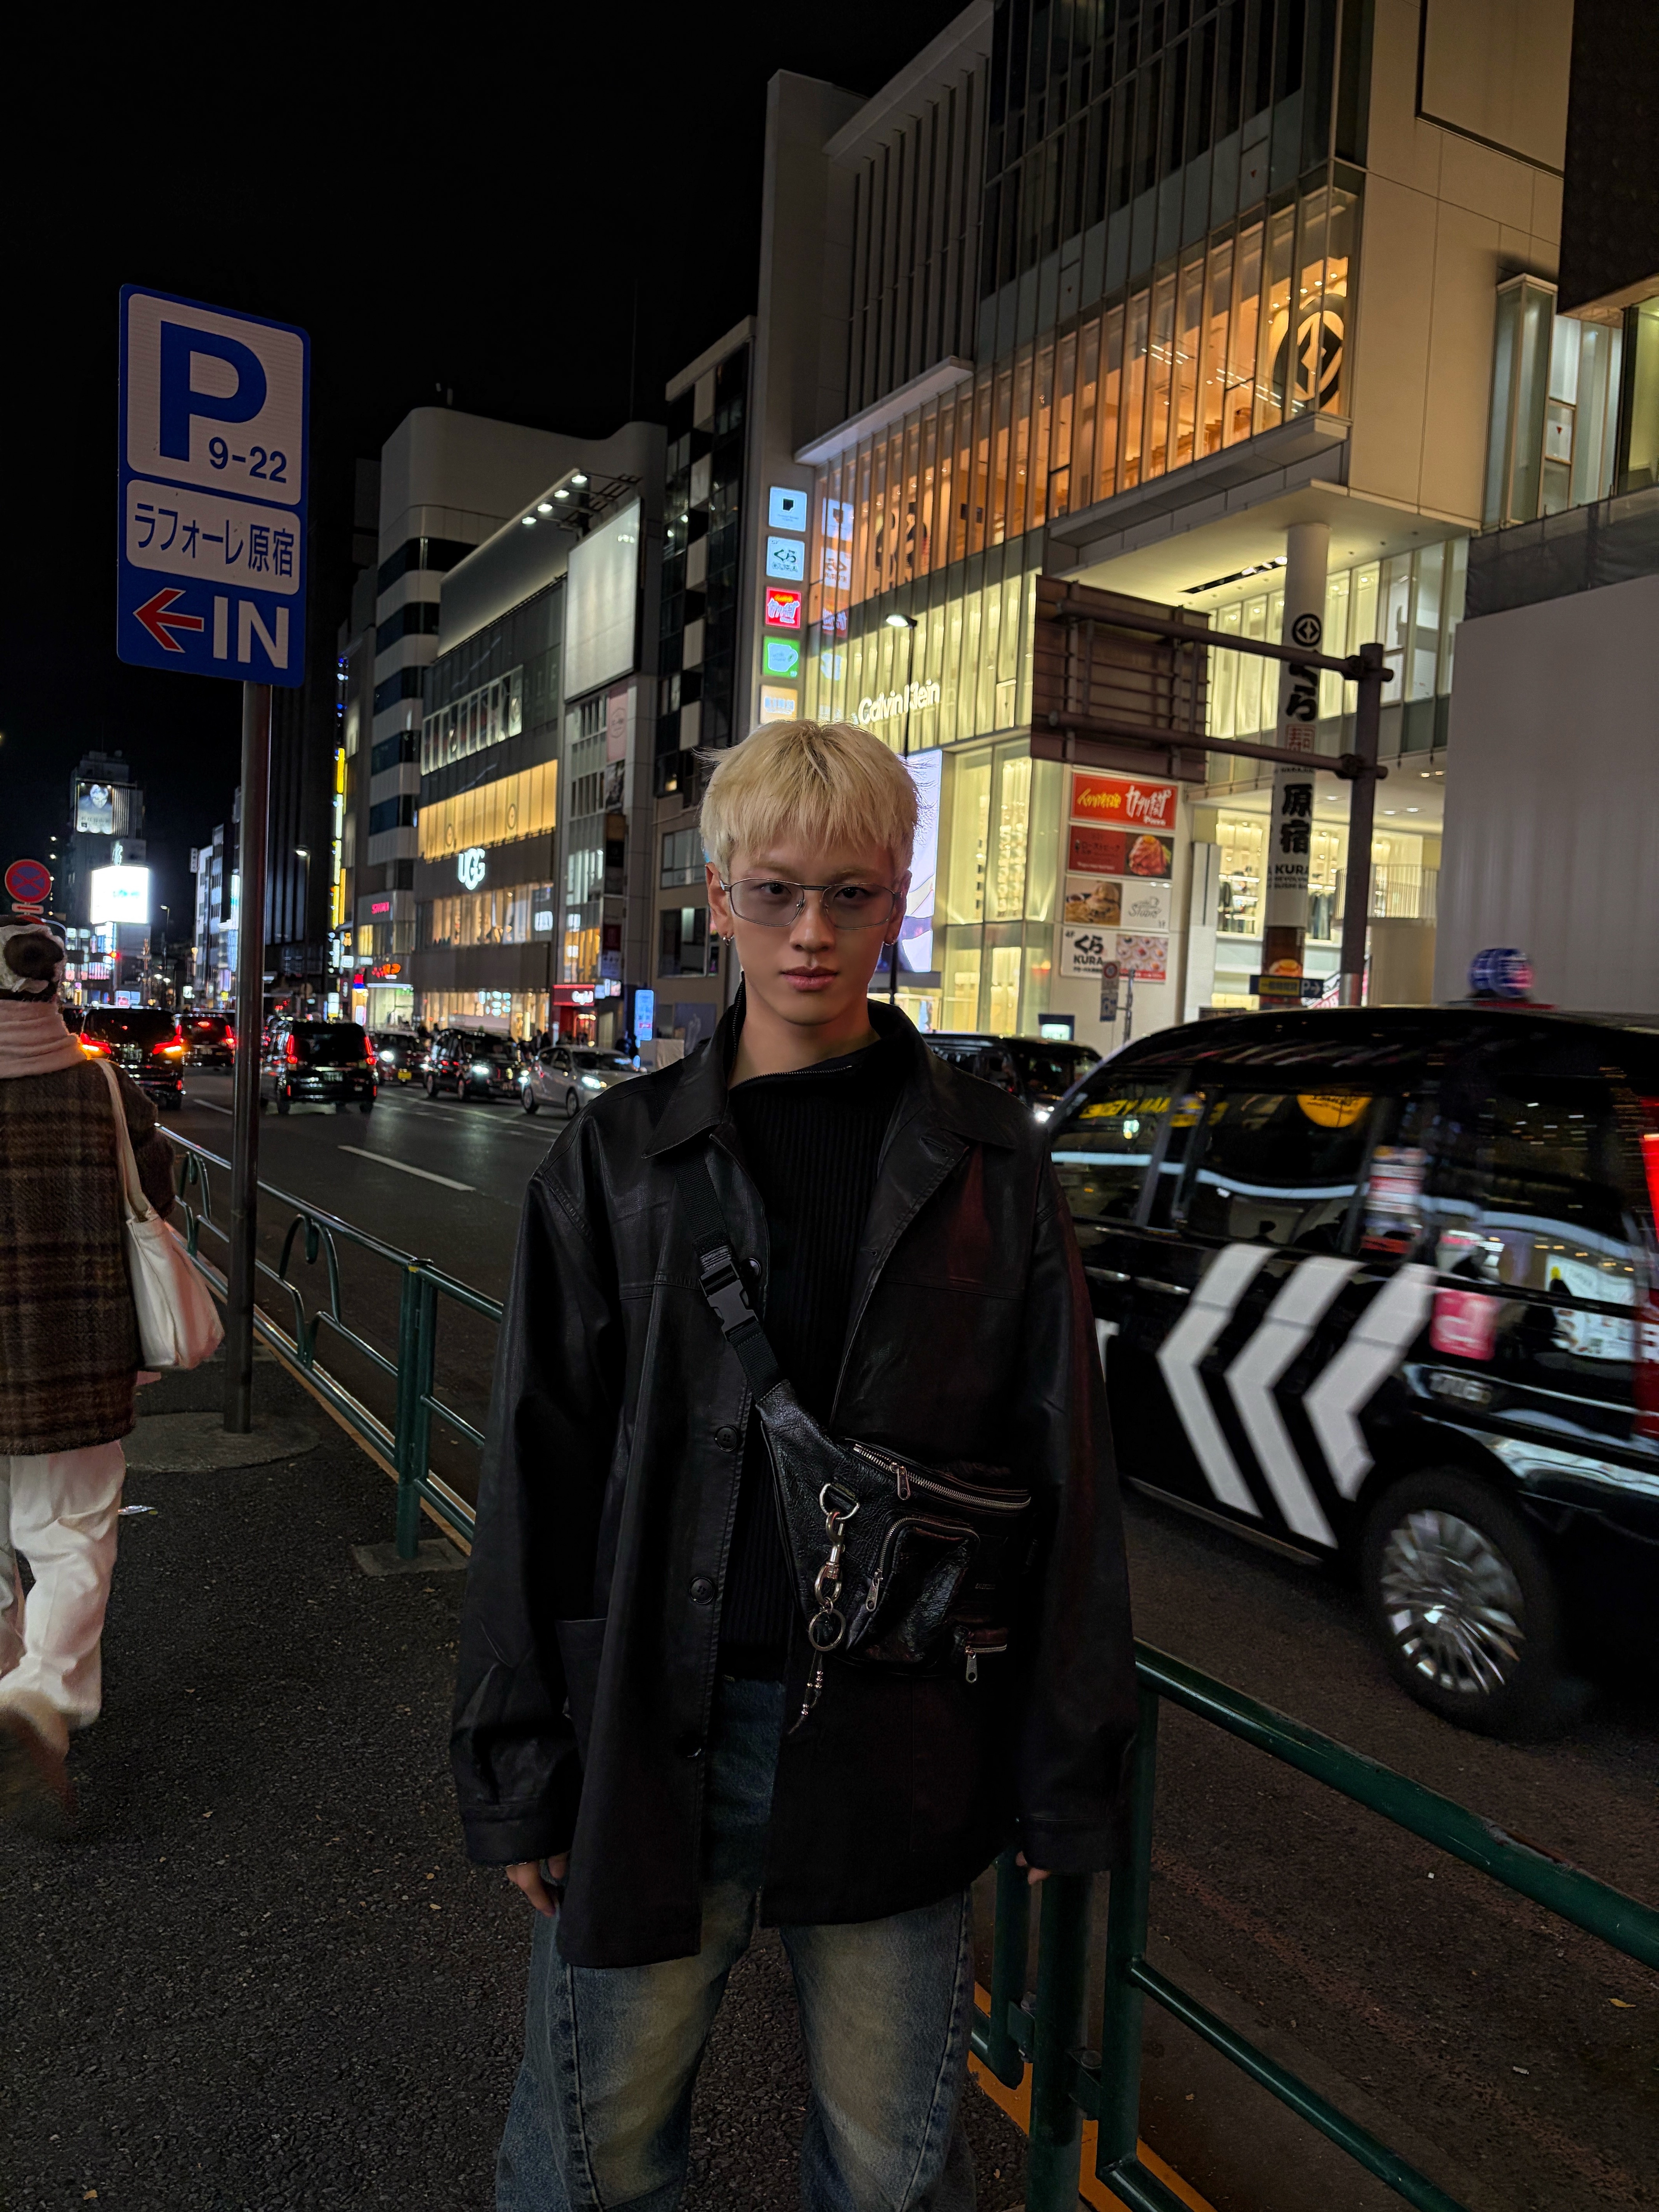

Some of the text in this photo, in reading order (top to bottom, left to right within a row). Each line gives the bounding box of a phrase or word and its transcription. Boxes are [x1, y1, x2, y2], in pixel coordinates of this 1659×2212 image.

[160, 320, 267, 462] P
[208, 436, 287, 483] 9-22
[134, 503, 294, 578] ラフォーレ原宿
[213, 595, 289, 669] IN
[858, 690, 903, 724] Calvin
[1280, 783, 1312, 854] 原宿
[458, 848, 485, 890] UGG
[1073, 954, 1103, 965] KURA
[1074, 934, 1104, 954] くら
